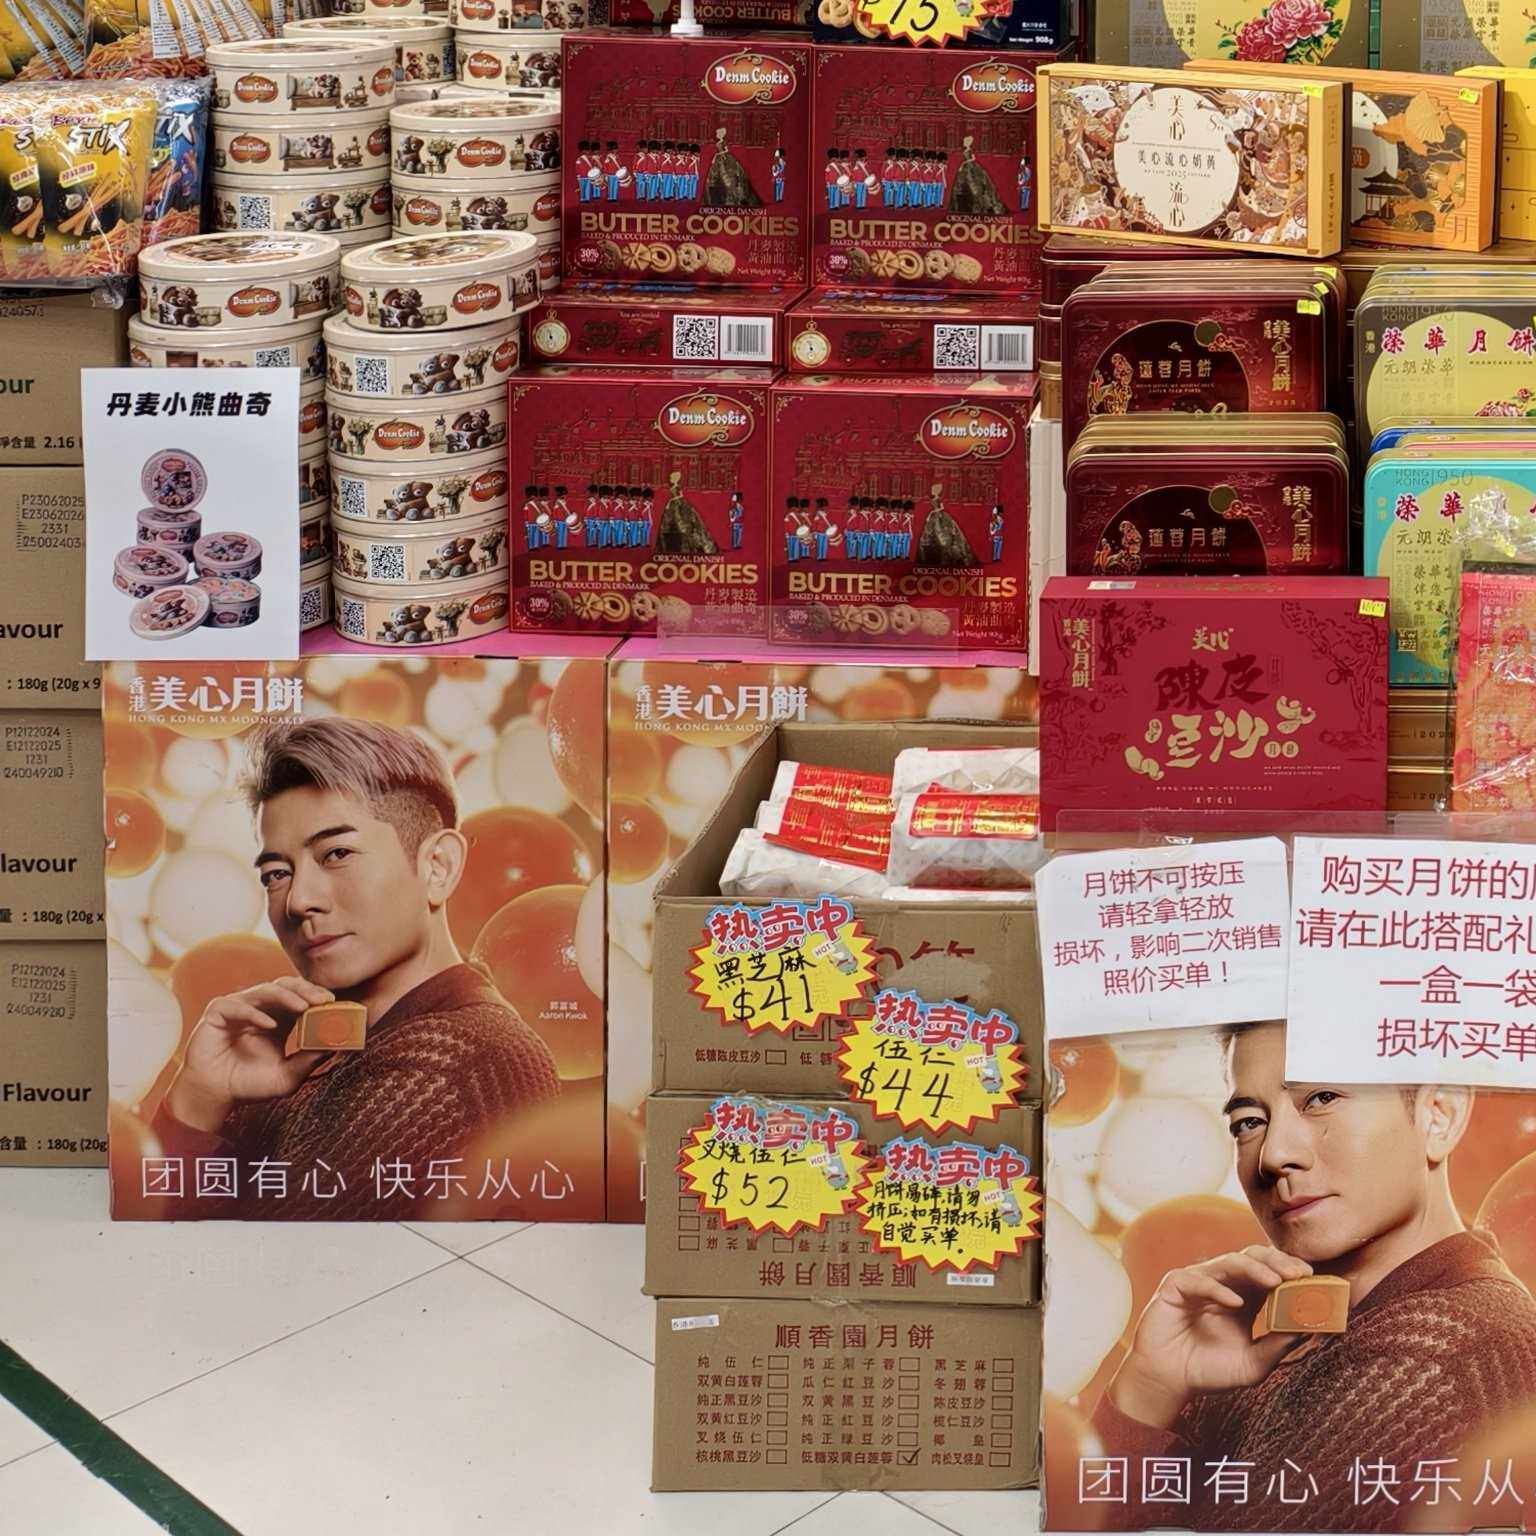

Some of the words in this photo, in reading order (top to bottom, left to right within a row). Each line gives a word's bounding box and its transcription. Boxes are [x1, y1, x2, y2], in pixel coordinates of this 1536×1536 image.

[580, 212, 678, 233] BUTTER
[686, 215, 800, 236] COOKIES
[829, 218, 926, 243] BUTTER
[934, 219, 1045, 246] COOKIES
[106, 391, 272, 418] 丹麦小熊曲奇
[529, 560, 633, 582] BUTTER
[640, 564, 758, 584] COOKIES
[1071, 618, 1091, 688] 美心月餅
[150, 676, 304, 714] 美心月餅
[656, 684, 809, 722] 美心月餅
[1082, 860, 1246, 898] 月饼不可按压
[33, 910, 63, 924] 180g
[66, 910, 93, 924] (20g
[1098, 893, 1234, 929] 请轻拿轻放
[711, 901, 849, 955] 热卖中
[1053, 924, 1282, 966] 损坏，影响二次销售
[715, 946, 816, 991] 黑芝麻
[733, 973, 815, 1021] $41
[874, 1040, 955, 1067] 伍仁
[3, 1082, 91, 1102] Flavour
[858, 1064, 955, 1119] $44
[717, 1101, 851, 1153] 热卖中
[47, 1138, 77, 1153] 180g
[698, 1139, 807, 1166] 叉烧伍仁
[142, 1157, 346, 1200] 团圆有心
[370, 1157, 575, 1201] 快乐从心
[711, 1167, 790, 1210] $52
[759, 1260, 917, 1288] 順香園月餅
[775, 1323, 934, 1350] 順香園月餅
[801, 1394, 895, 1409] 双黄黑豆沙
[697, 1412, 762, 1426] 双黄红豆沙
[696, 1450, 762, 1464] 核桃黑豆沙
[1078, 1455, 1319, 1508] 团圆有心
